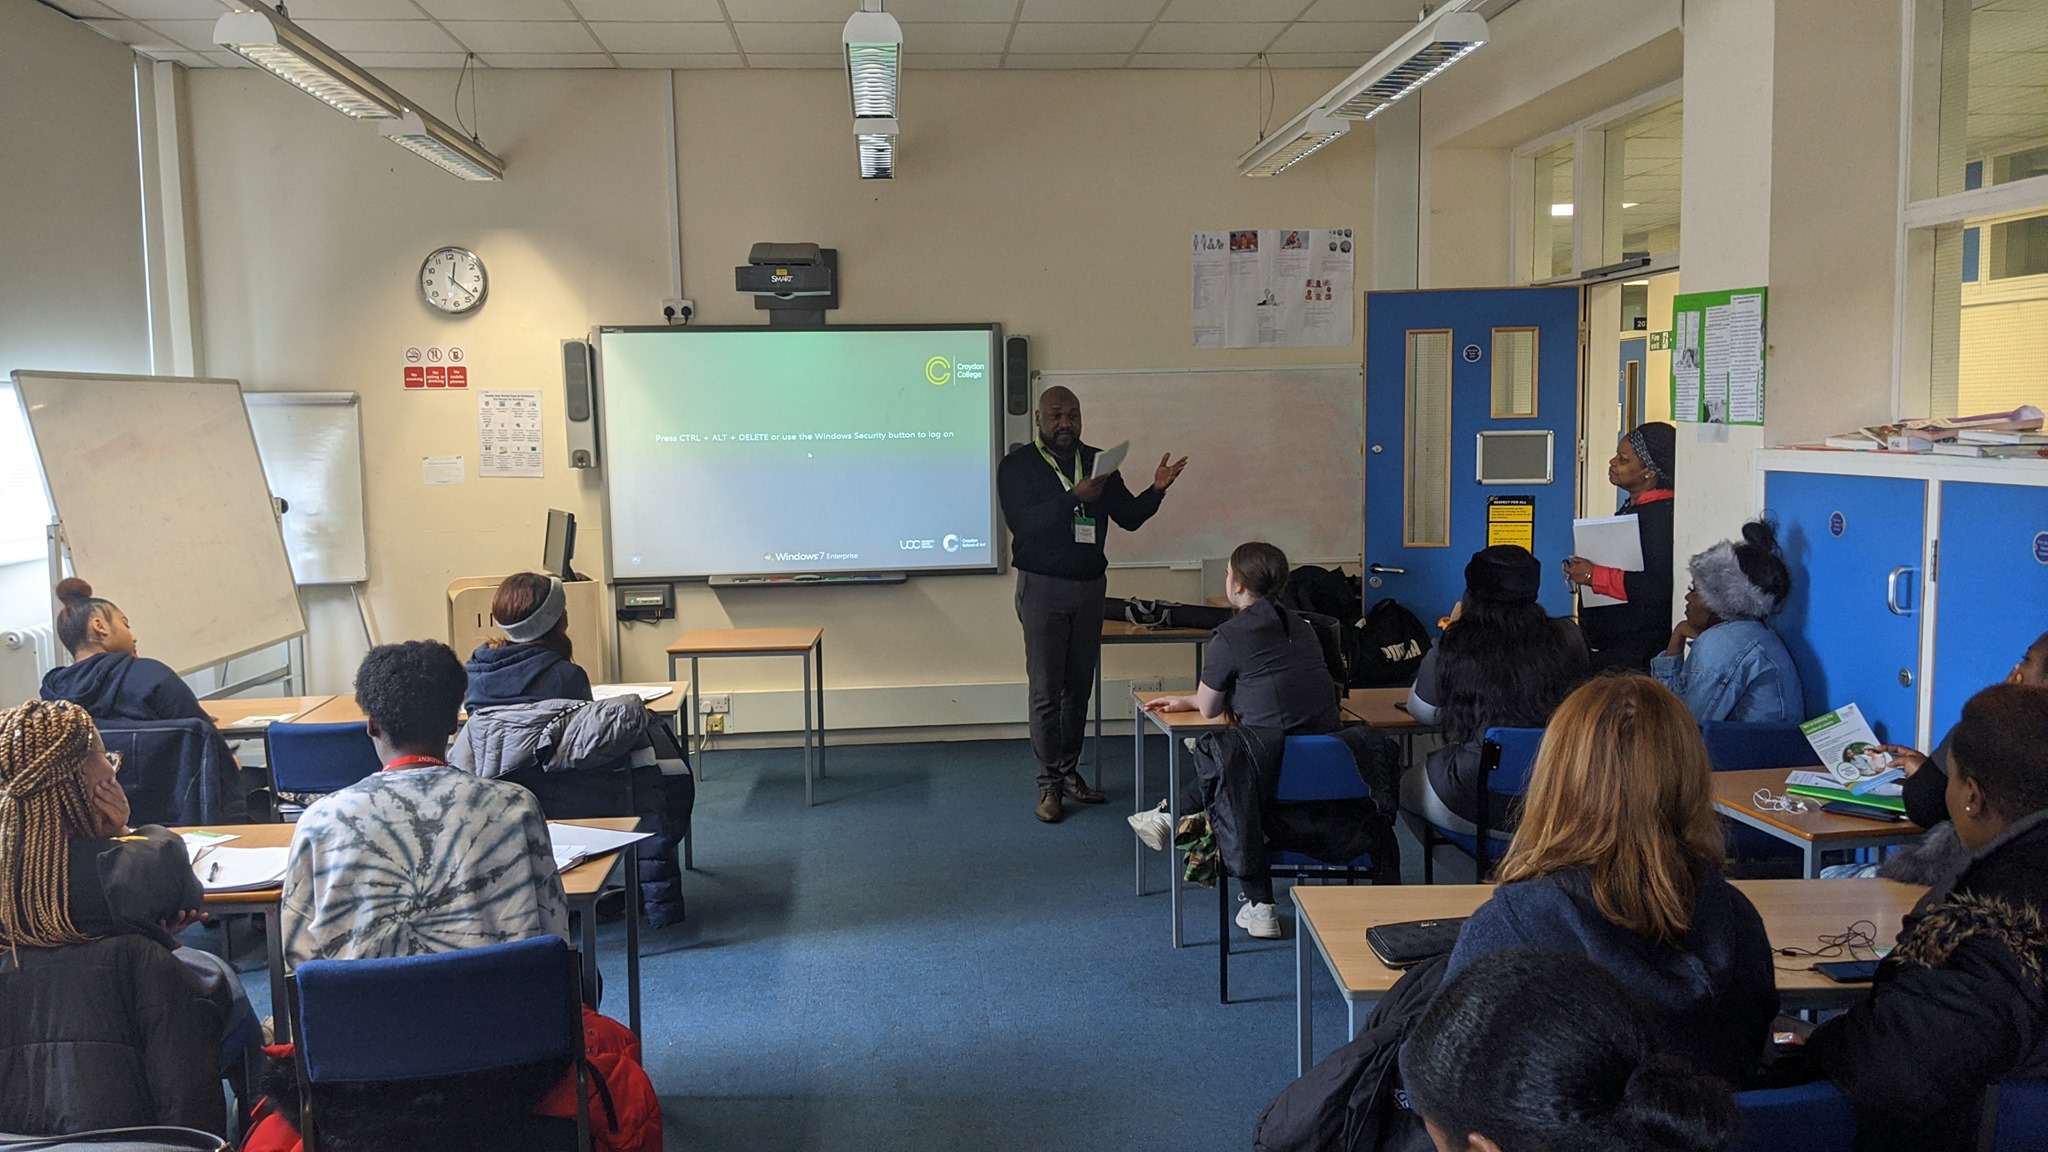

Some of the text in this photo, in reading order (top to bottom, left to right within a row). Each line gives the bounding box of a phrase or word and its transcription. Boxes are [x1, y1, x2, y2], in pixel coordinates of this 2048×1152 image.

[445, 253, 455, 261] 12
[957, 371, 982, 379] College
[854, 432, 886, 440] Security
[928, 430, 940, 440] log
[775, 552, 819, 560] Windows
[826, 552, 858, 560] Enterprise
